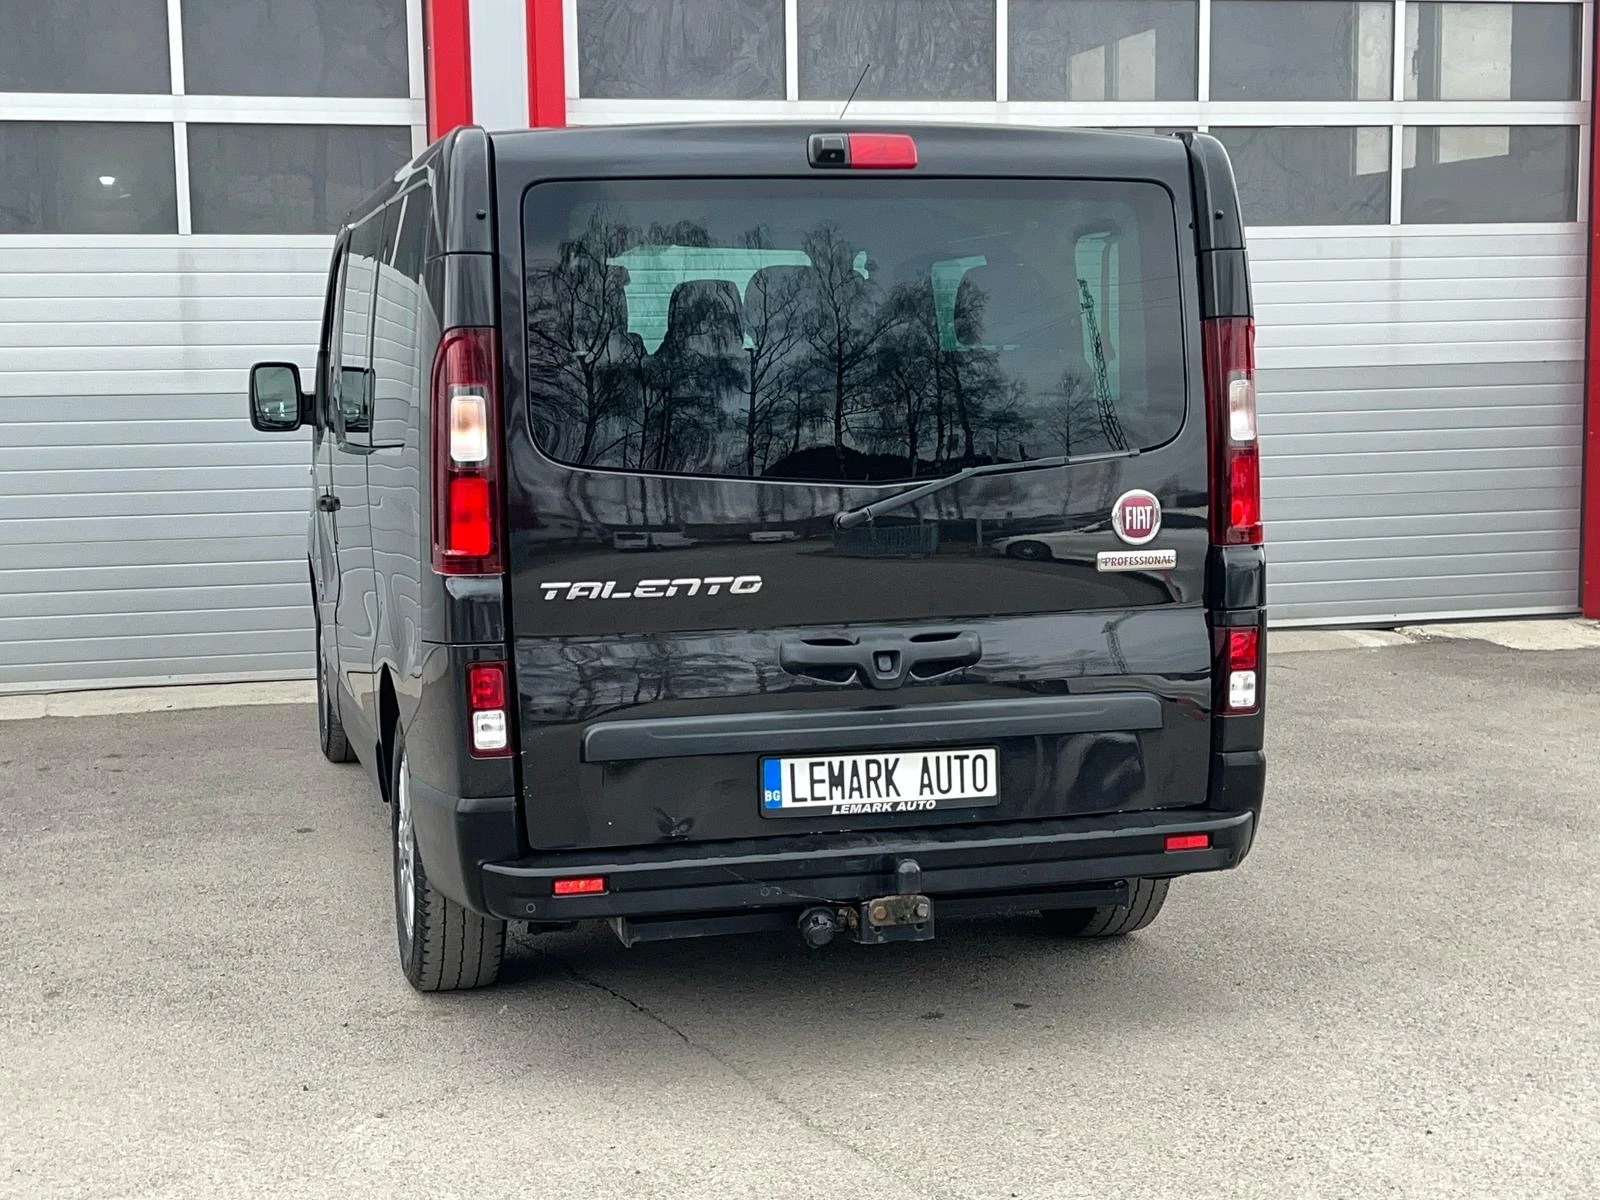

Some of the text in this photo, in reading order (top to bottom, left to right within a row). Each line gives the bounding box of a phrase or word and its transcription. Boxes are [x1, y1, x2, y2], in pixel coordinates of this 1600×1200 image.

[1125, 506, 1152, 530] FIAT
[1103, 556, 1174, 566] PROFESSIONAL
[540, 575, 763, 600] TALENTO
[790, 754, 988, 802] LEMARK AUTO
[764, 790, 781, 801] BG
[831, 800, 936, 815] LEMARK AUTO
